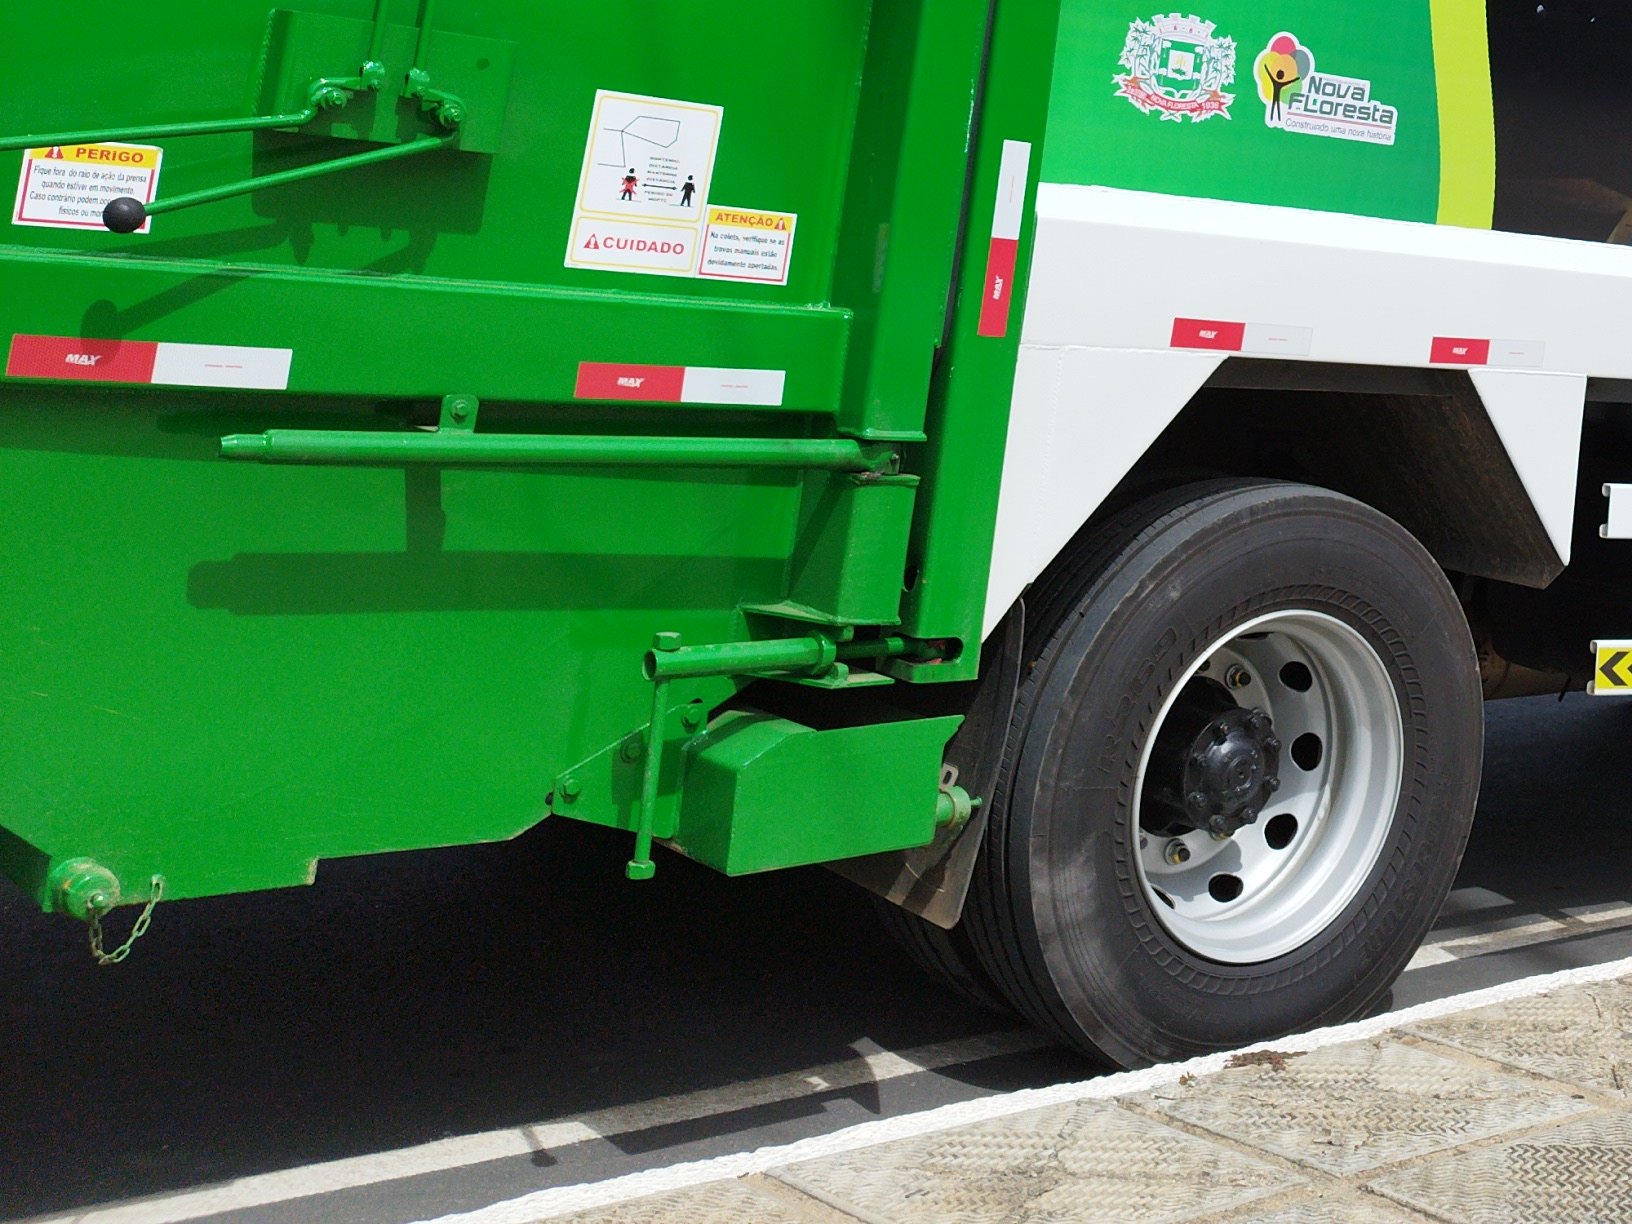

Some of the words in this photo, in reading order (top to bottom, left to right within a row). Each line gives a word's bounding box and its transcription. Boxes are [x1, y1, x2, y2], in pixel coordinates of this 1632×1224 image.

[1308, 75, 1366, 102] Nova
[75, 147, 144, 163] PERIGO
[603, 236, 685, 255] CUIDADO
[65, 353, 102, 366] MAX
[617, 377, 646, 388] MAX
